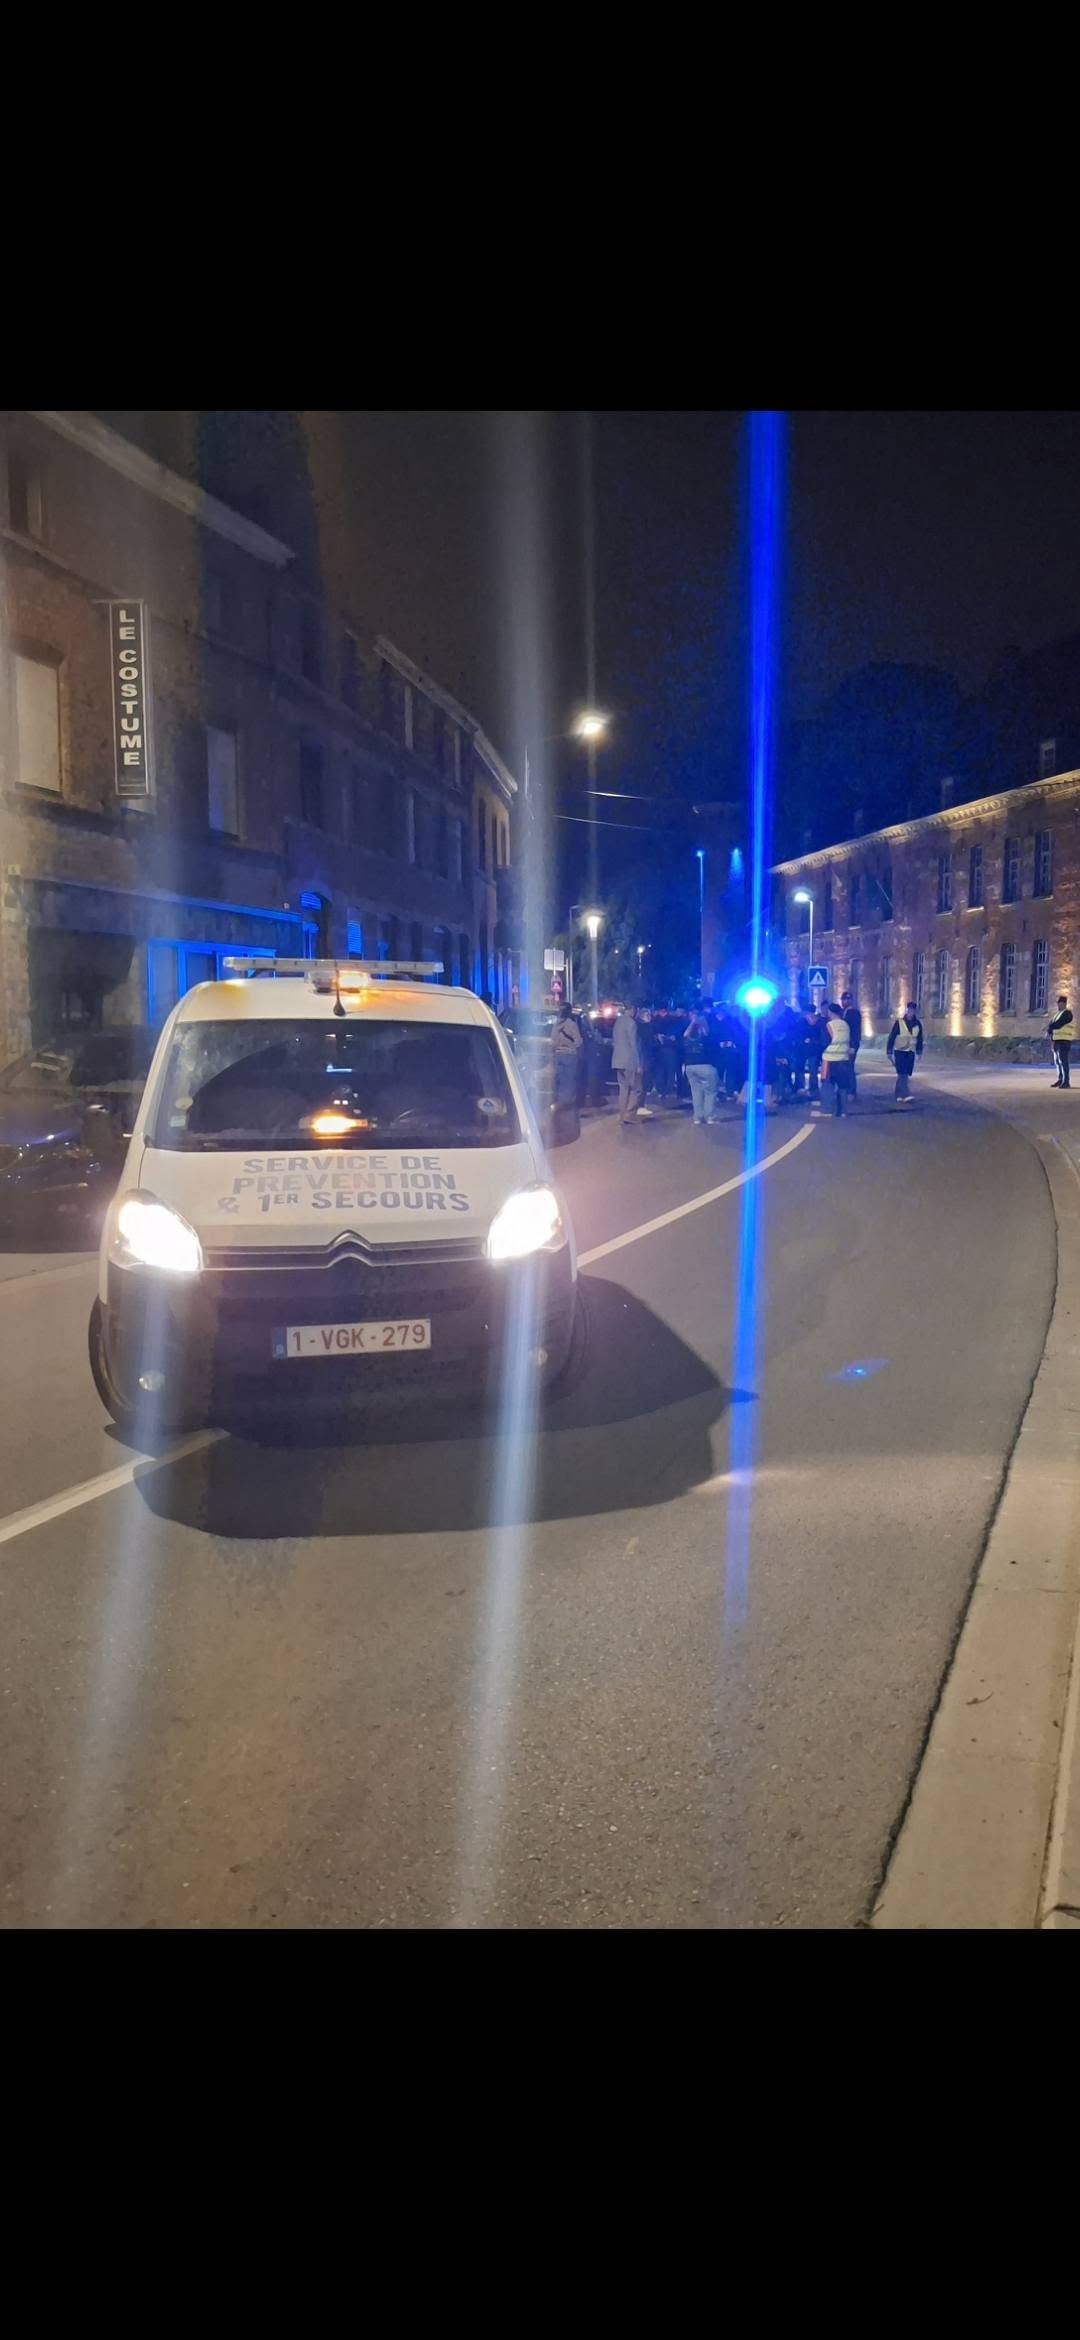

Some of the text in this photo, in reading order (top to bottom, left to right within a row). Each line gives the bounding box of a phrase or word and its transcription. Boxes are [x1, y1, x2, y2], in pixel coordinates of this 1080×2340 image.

[118, 609, 142, 766] LE COSTUME
[242, 1156, 442, 1173] SERVICE DE
[232, 1173, 457, 1194] PREVENTION
[217, 1197, 241, 1214] &
[312, 1191, 470, 1212] SECOURS
